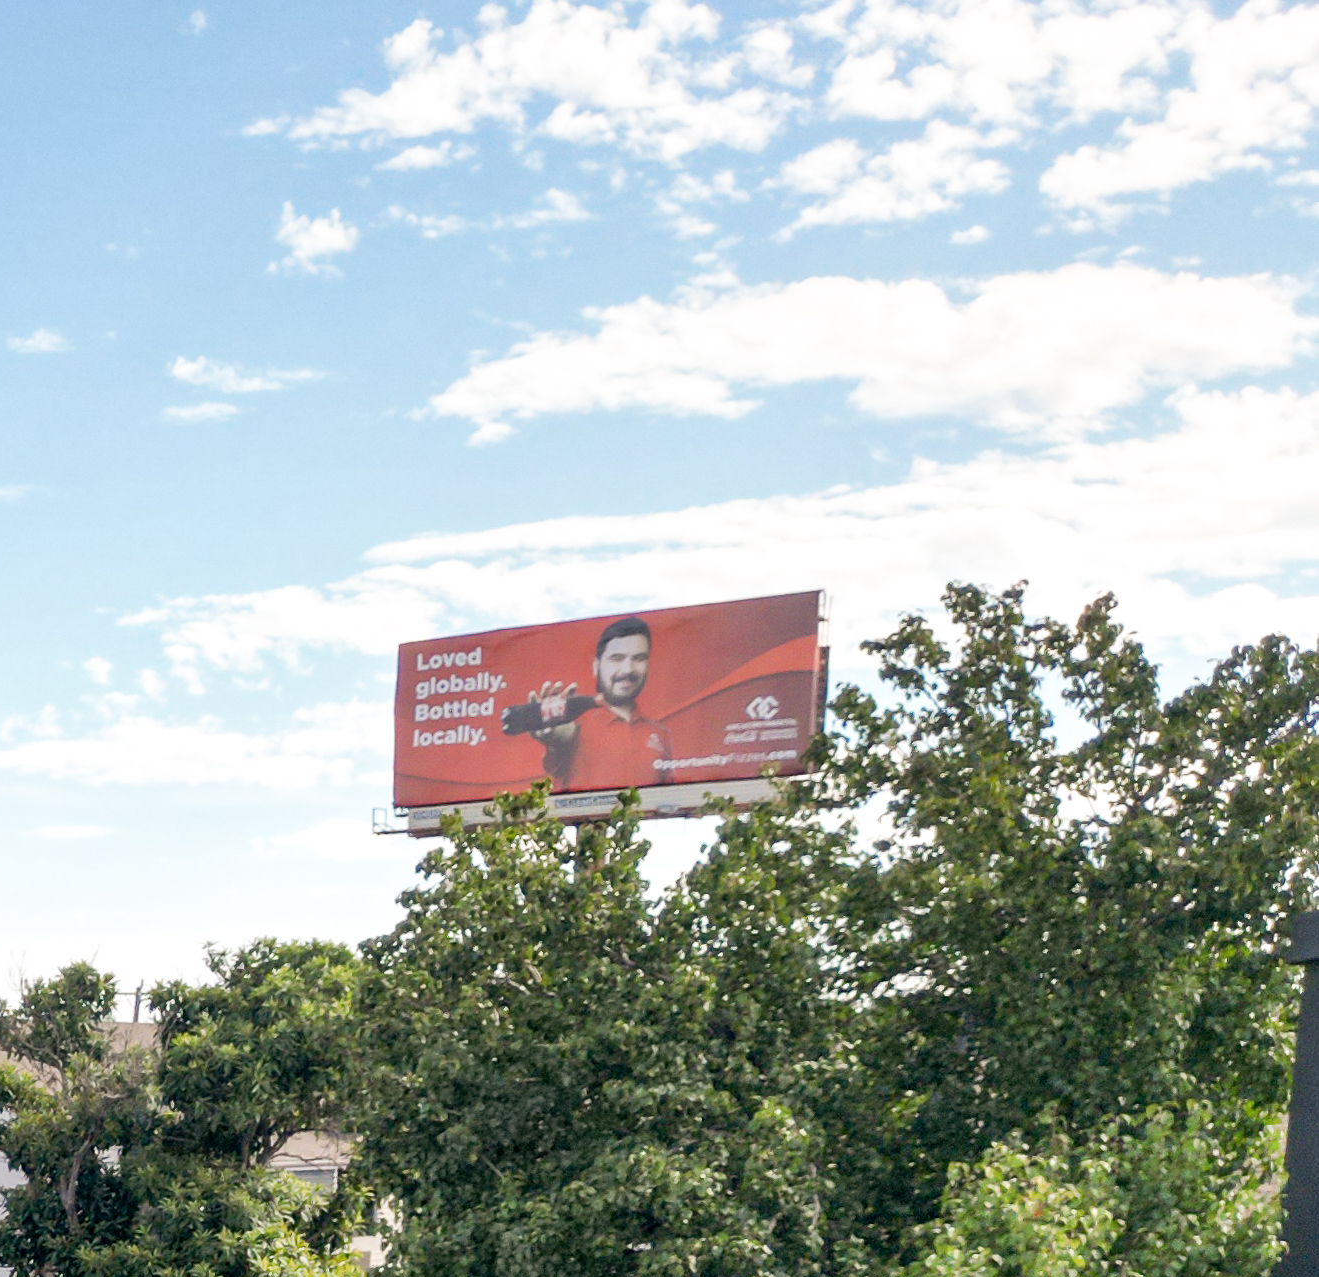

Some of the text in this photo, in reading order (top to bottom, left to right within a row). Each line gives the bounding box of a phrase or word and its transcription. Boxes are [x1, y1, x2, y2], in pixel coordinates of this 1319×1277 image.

[416, 647, 482, 671] Loved
[415, 671, 507, 699] globally.
[415, 697, 495, 722] Bottled
[413, 725, 487, 747] locally.
